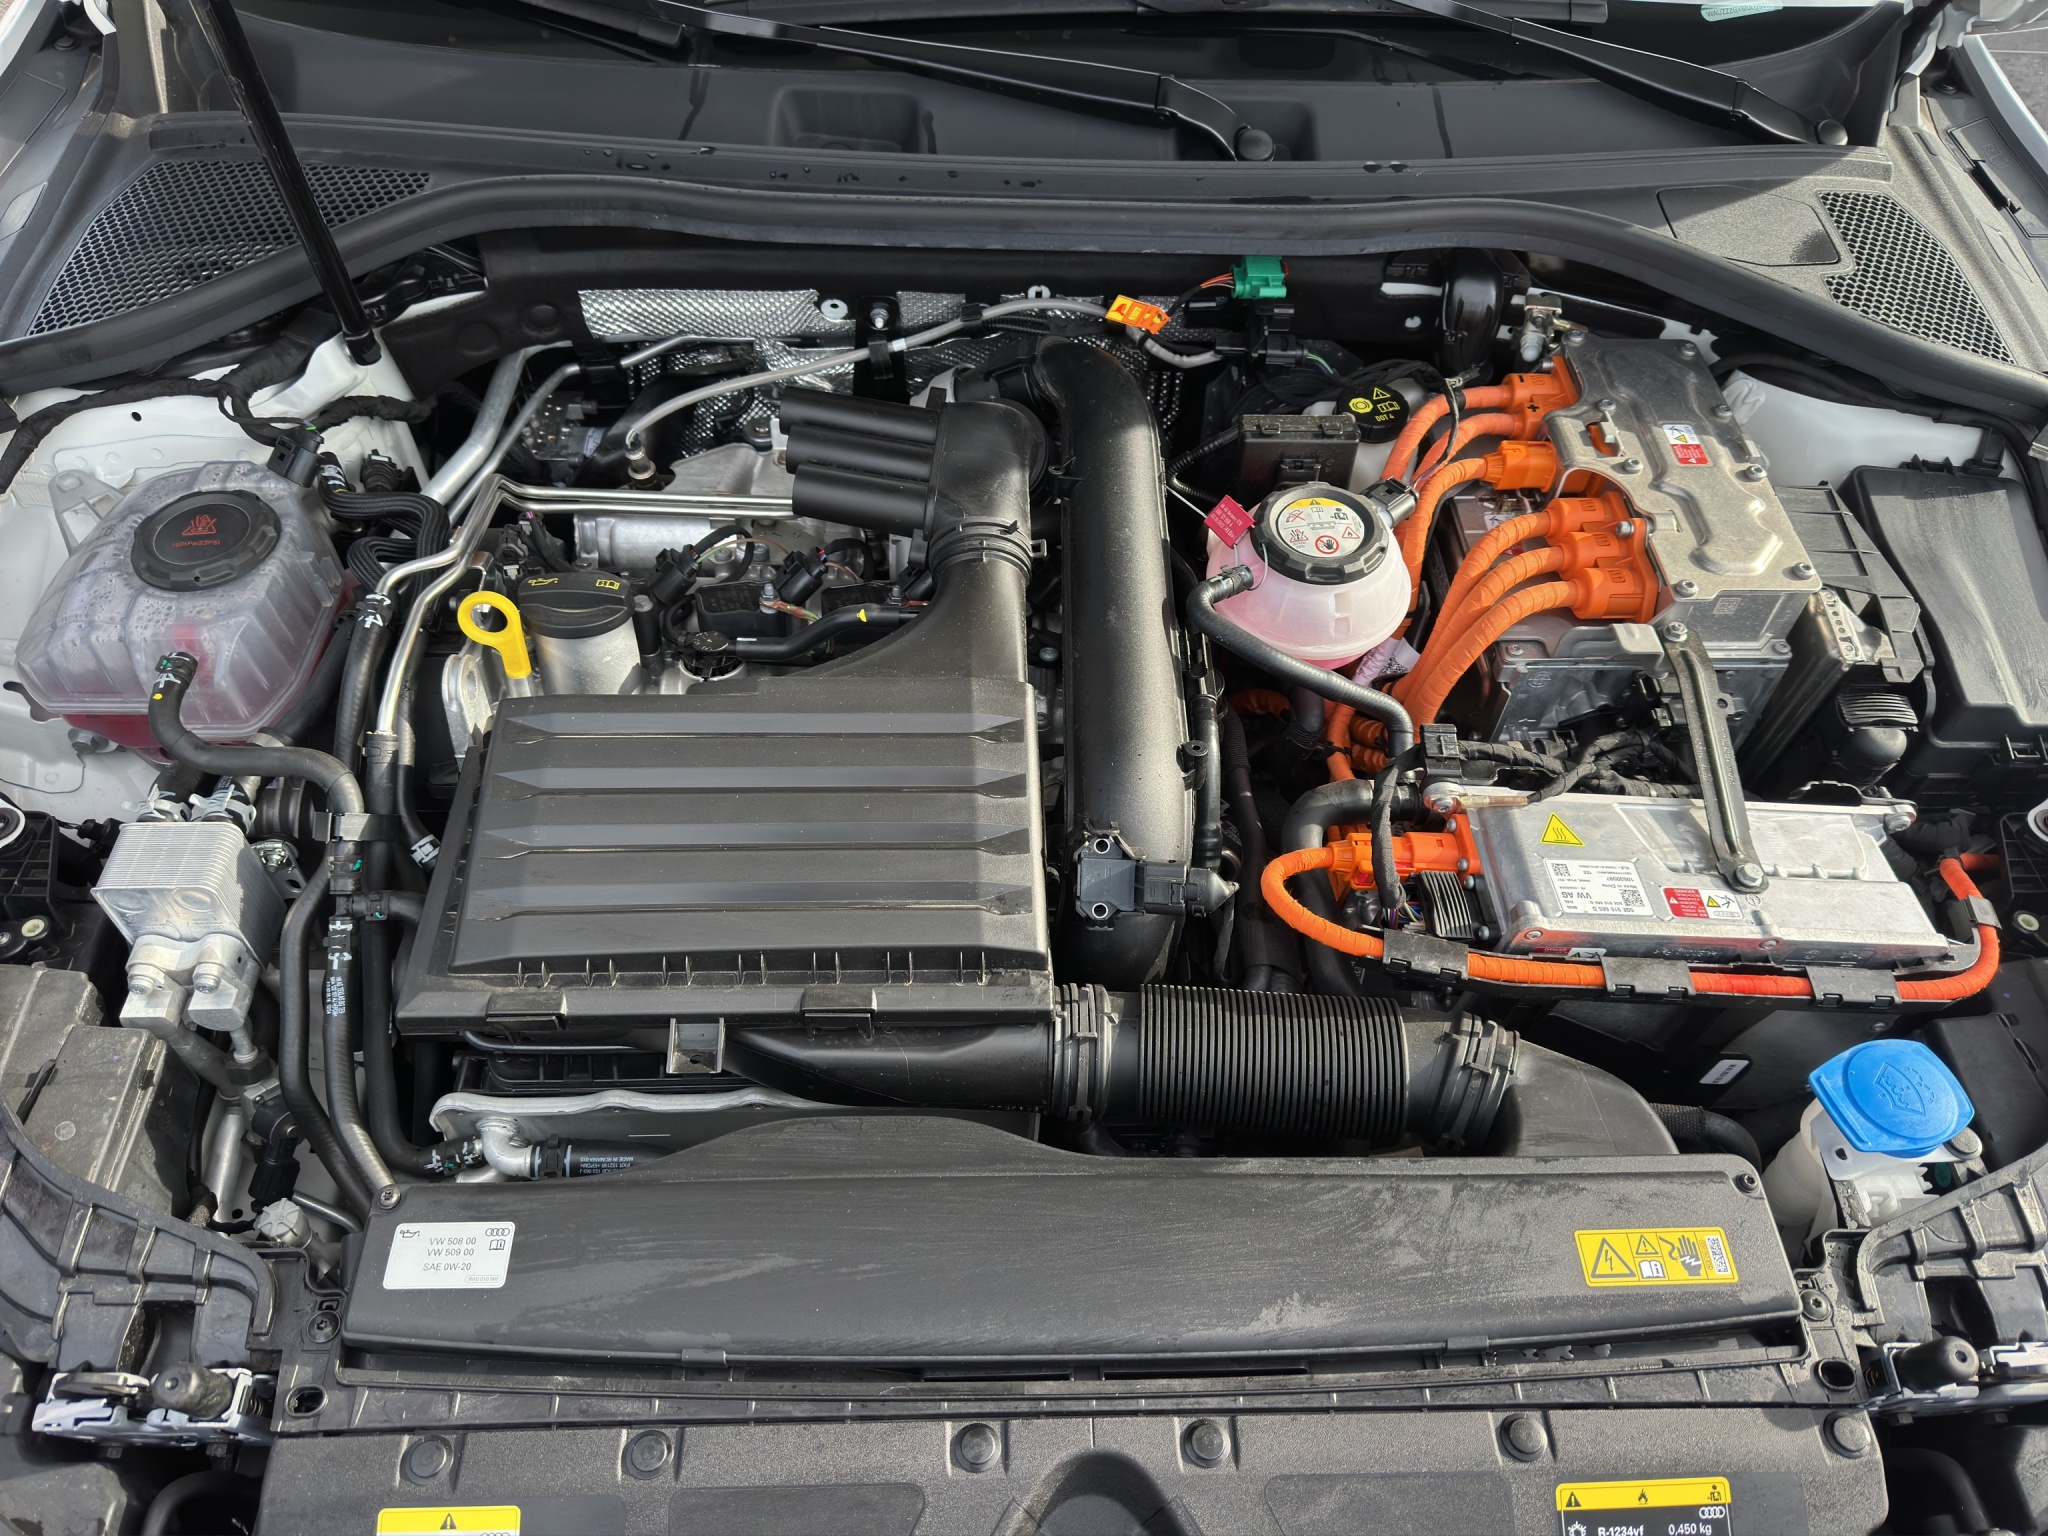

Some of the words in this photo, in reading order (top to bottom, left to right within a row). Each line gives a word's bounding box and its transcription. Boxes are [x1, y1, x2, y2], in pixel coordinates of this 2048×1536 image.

[1375, 413, 1389, 422] DOT
[1561, 891, 1574, 899] AG
[430, 1237, 446, 1245] VW
[447, 1237, 464, 1245] 508
[465, 1237, 477, 1245] 00
[427, 1248, 443, 1256] VW
[444, 1248, 461, 1256] 509
[463, 1248, 475, 1256] 00
[423, 1262, 442, 1271] SAE
[443, 1262, 472, 1271] 0W-20
[1668, 1523, 1697, 1536] 0,450
[1700, 1523, 1712, 1536] kg
